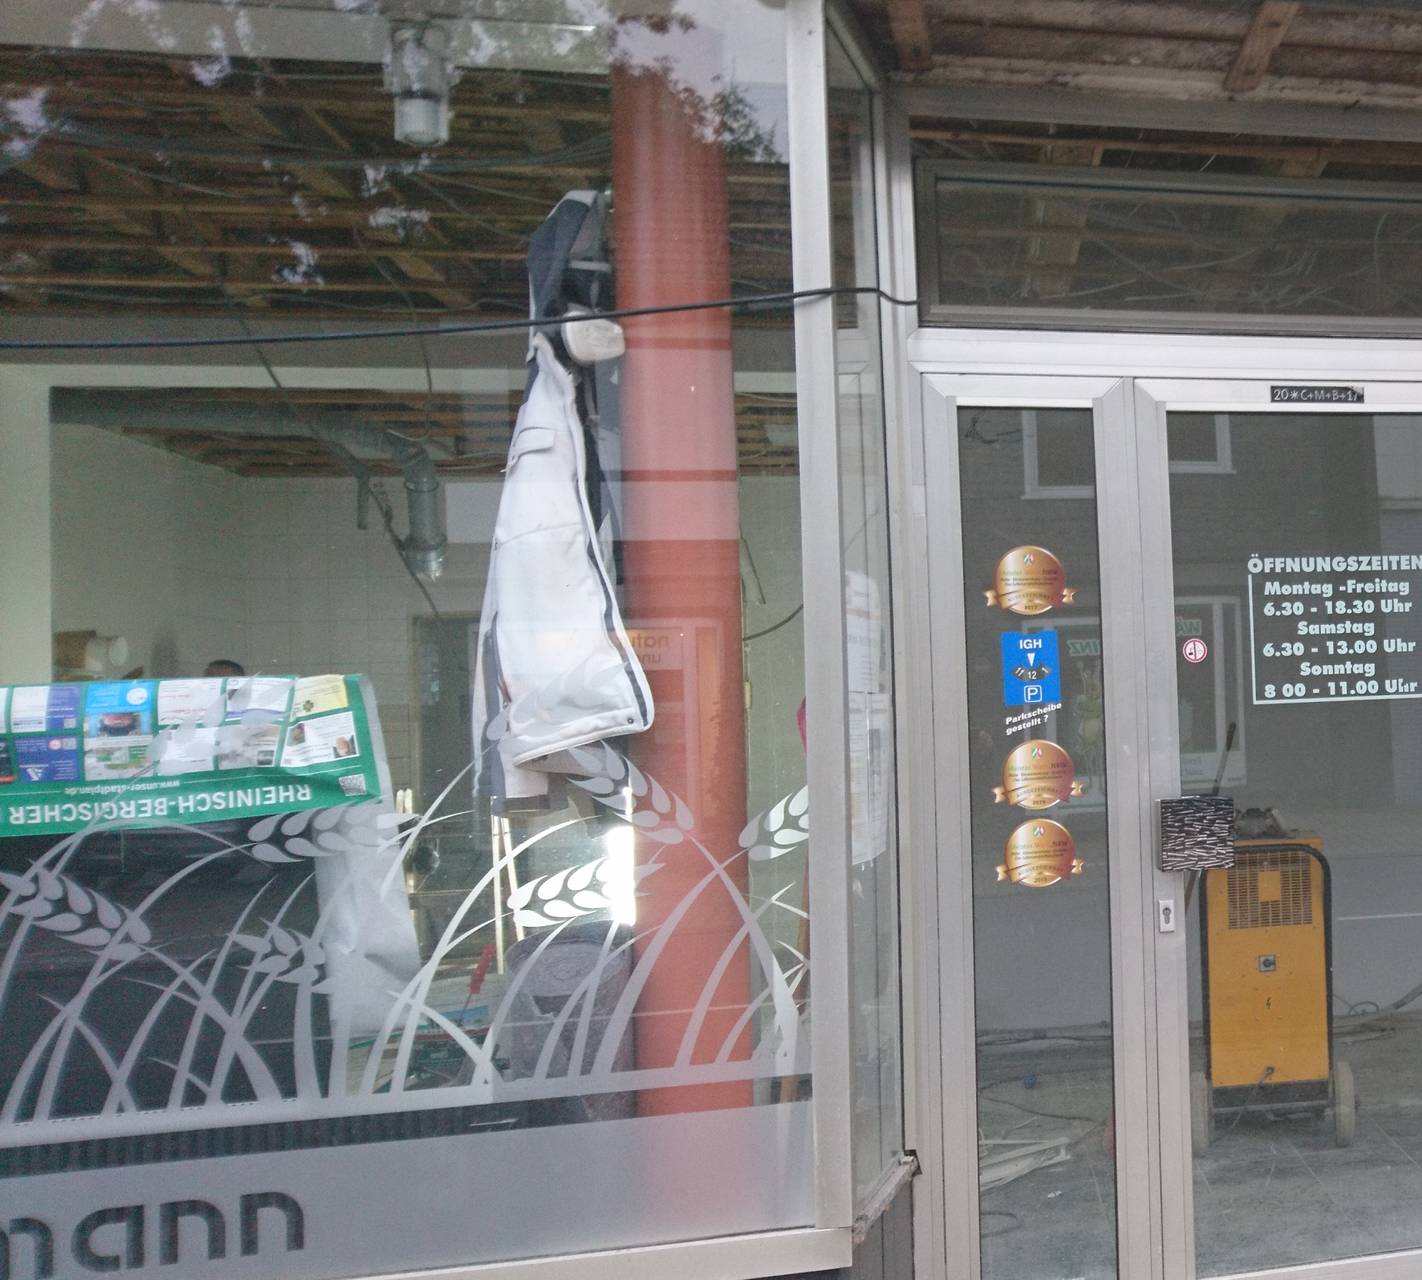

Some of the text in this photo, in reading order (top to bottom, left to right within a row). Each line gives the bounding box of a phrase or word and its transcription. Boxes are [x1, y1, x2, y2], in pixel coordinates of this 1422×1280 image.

[1264, 581, 1333, 597] Montag
[1263, 602, 1304, 616] 6.30
[1325, 600, 1375, 614] 18.30
[1380, 598, 1413, 613] Uhr
[1297, 620, 1375, 636] Samstag
[1020, 639, 1042, 649] IGH
[1263, 642, 1304, 657] 6.30
[1326, 640, 1377, 655] 13.00
[1383, 638, 1416, 653] Uhr
[1028, 671, 1037, 680] 12
[1300, 661, 1375, 677] Sonntag
[1027, 687, 1038, 701] P
[1328, 680, 1379, 695] 11.00
[1005, 703, 1062, 725] Parkscheibe
[1006, 718, 1041, 736] gestellt
[65, 779, 180, 795] www.unser-stadtplan.de
[9, 784, 312, 825] RHEINISCH-BERGISCHER
